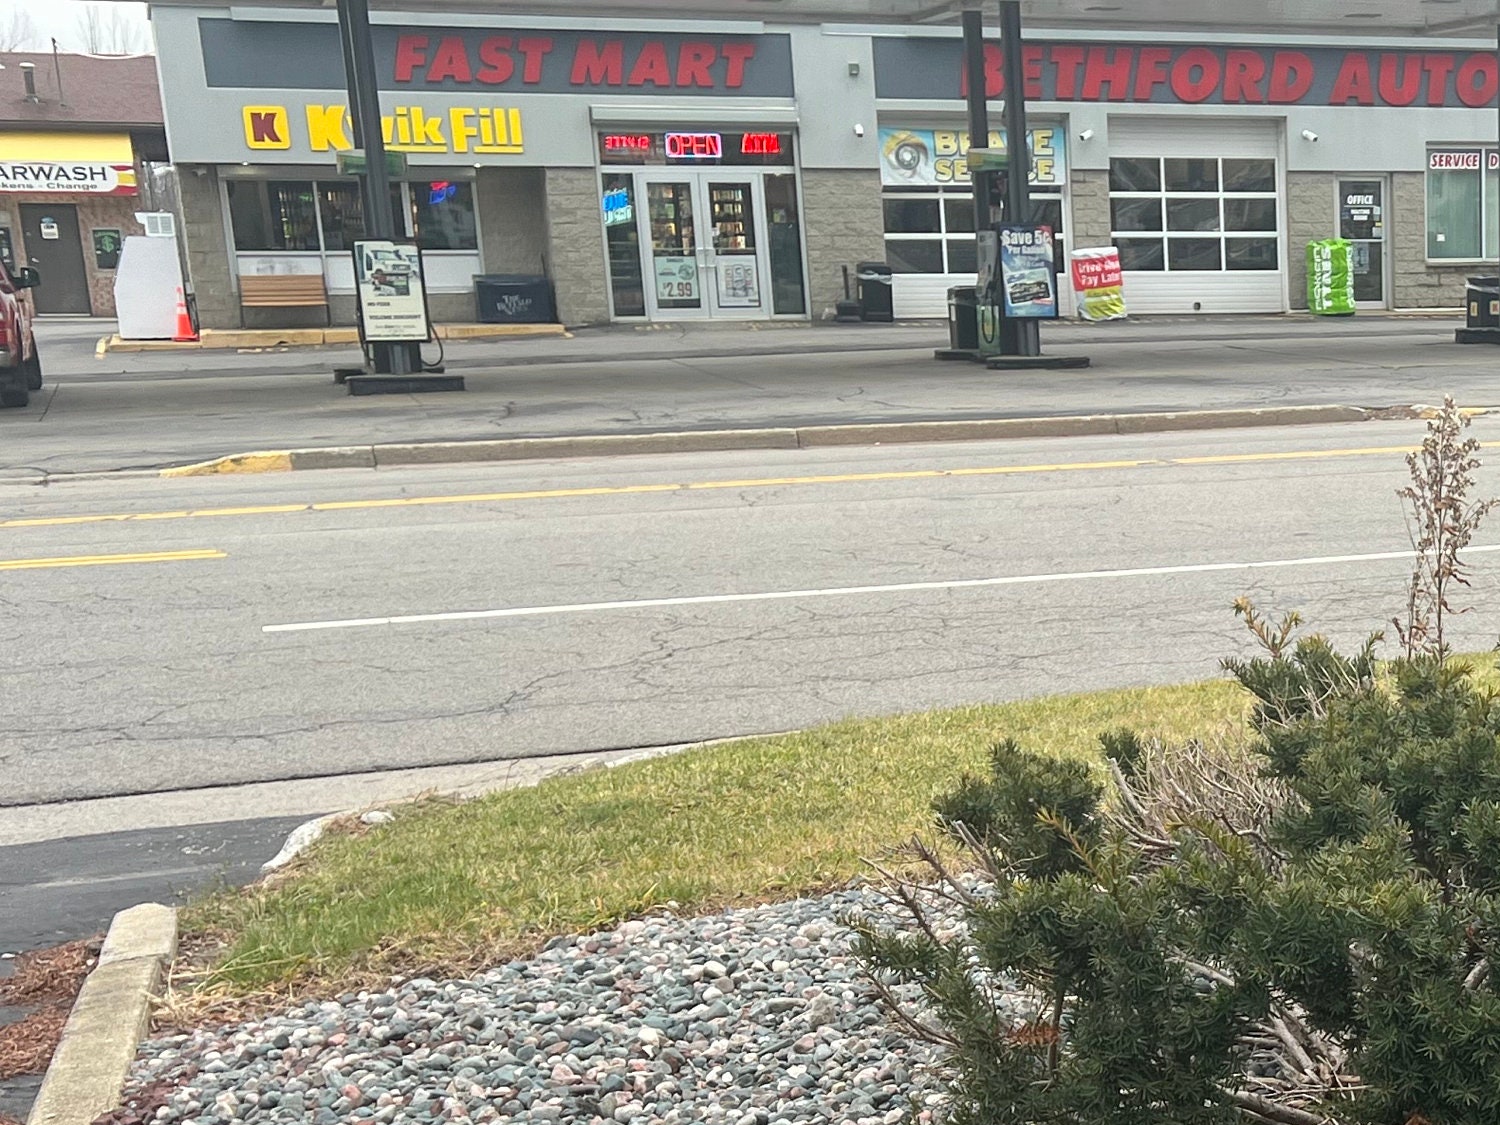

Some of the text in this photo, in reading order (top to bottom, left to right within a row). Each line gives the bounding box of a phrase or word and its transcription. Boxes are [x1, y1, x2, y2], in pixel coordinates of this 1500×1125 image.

[394, 36, 759, 87] FAST MART
[1329, 52, 1500, 108] AUTO
[449, 107, 525, 154] Fill
[668, 135, 719, 155] OPEN
[933, 129, 1054, 156] BRAE
[1430, 152, 1480, 169] SERVICE
[0, 166, 107, 181] ARWASH
[46, 182, 98, 190] Change
[1347, 195, 1374, 205] OFFICE
[1001, 230, 1033, 246] Save
[1081, 274, 1099, 287] Pay
